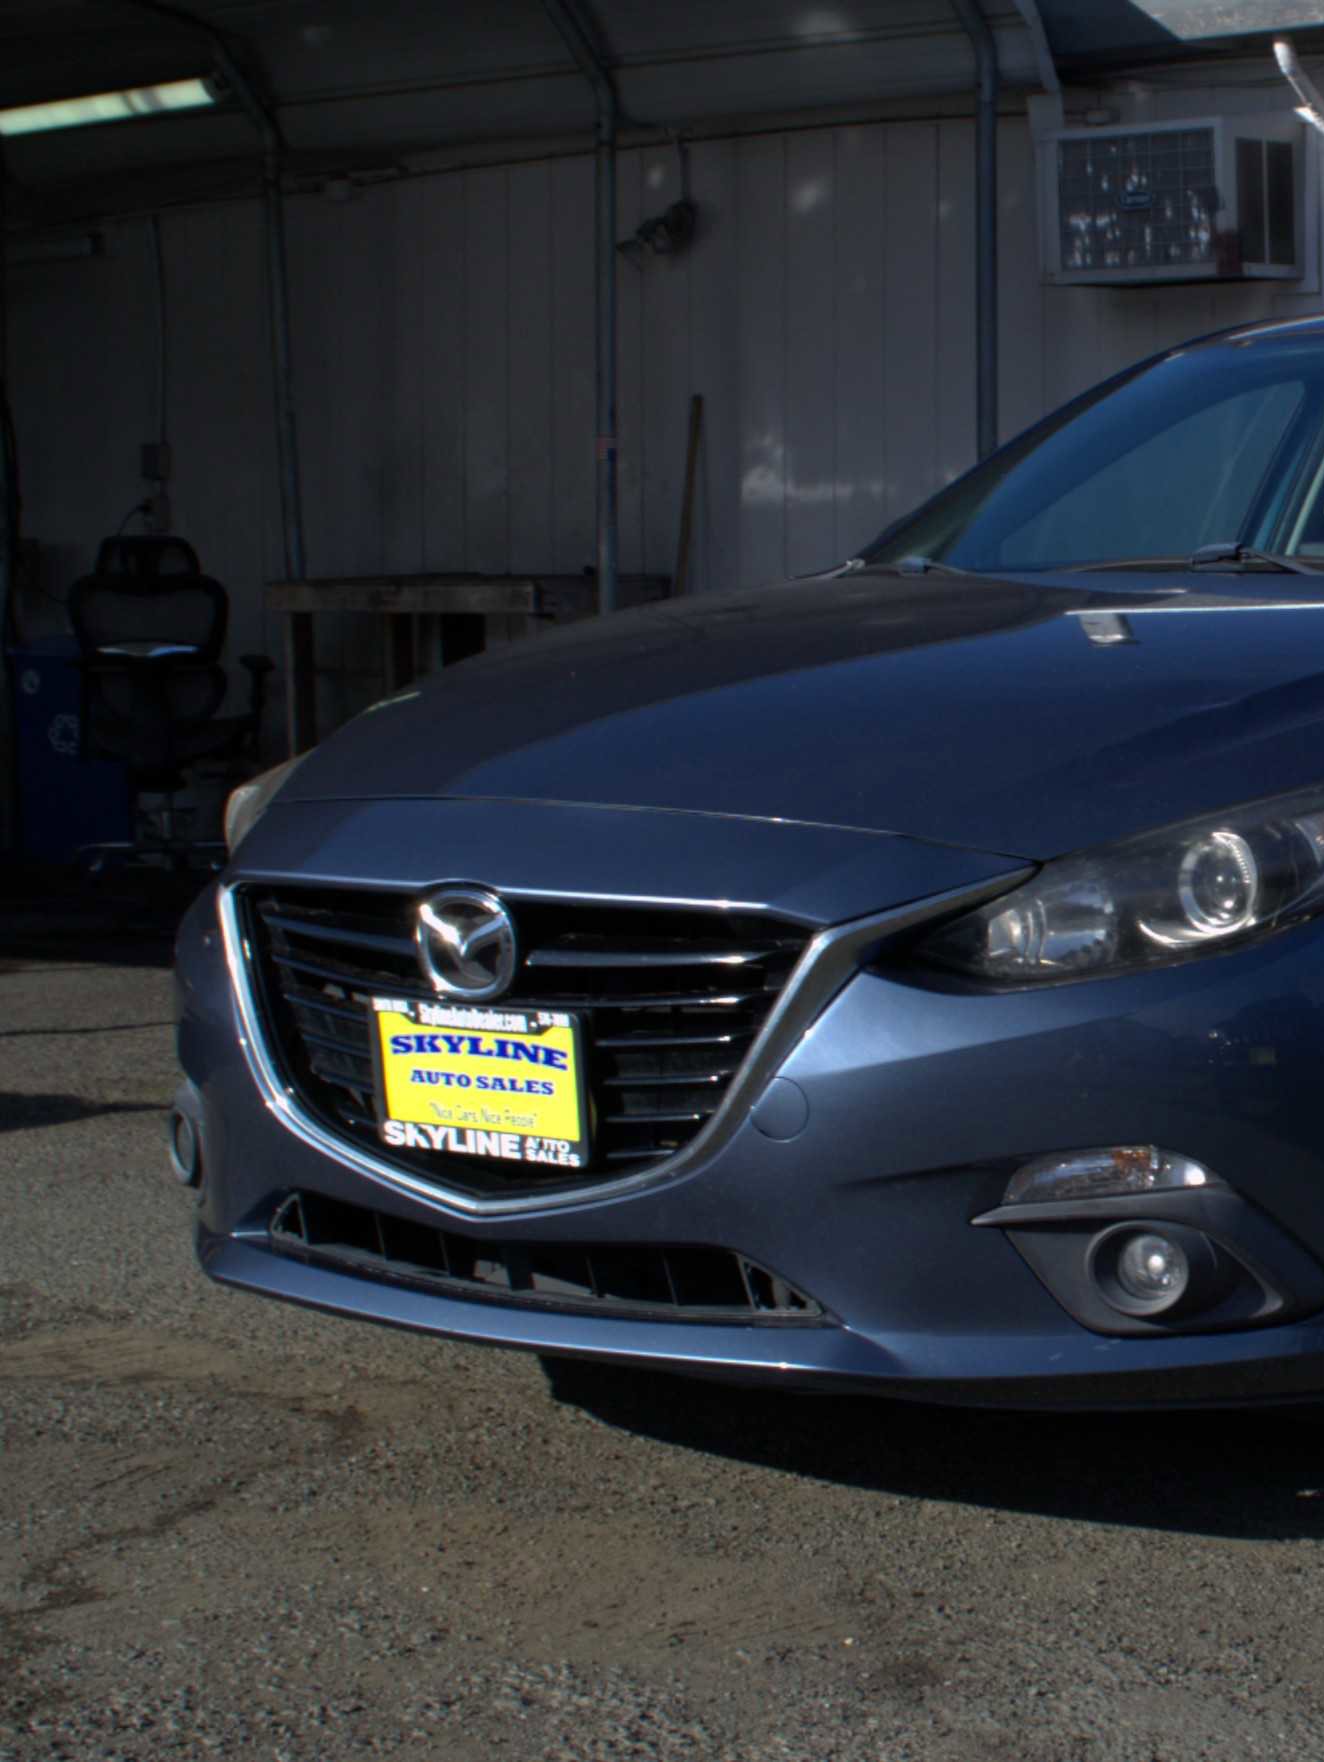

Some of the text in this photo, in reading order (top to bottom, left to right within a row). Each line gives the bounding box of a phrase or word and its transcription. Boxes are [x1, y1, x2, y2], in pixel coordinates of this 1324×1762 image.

[390, 1035, 568, 1070] SKYLINE
[410, 1070, 554, 1095] AUTO SALES
[383, 1120, 522, 1160] SKYLINE
[526, 1149, 581, 1168] SALES
